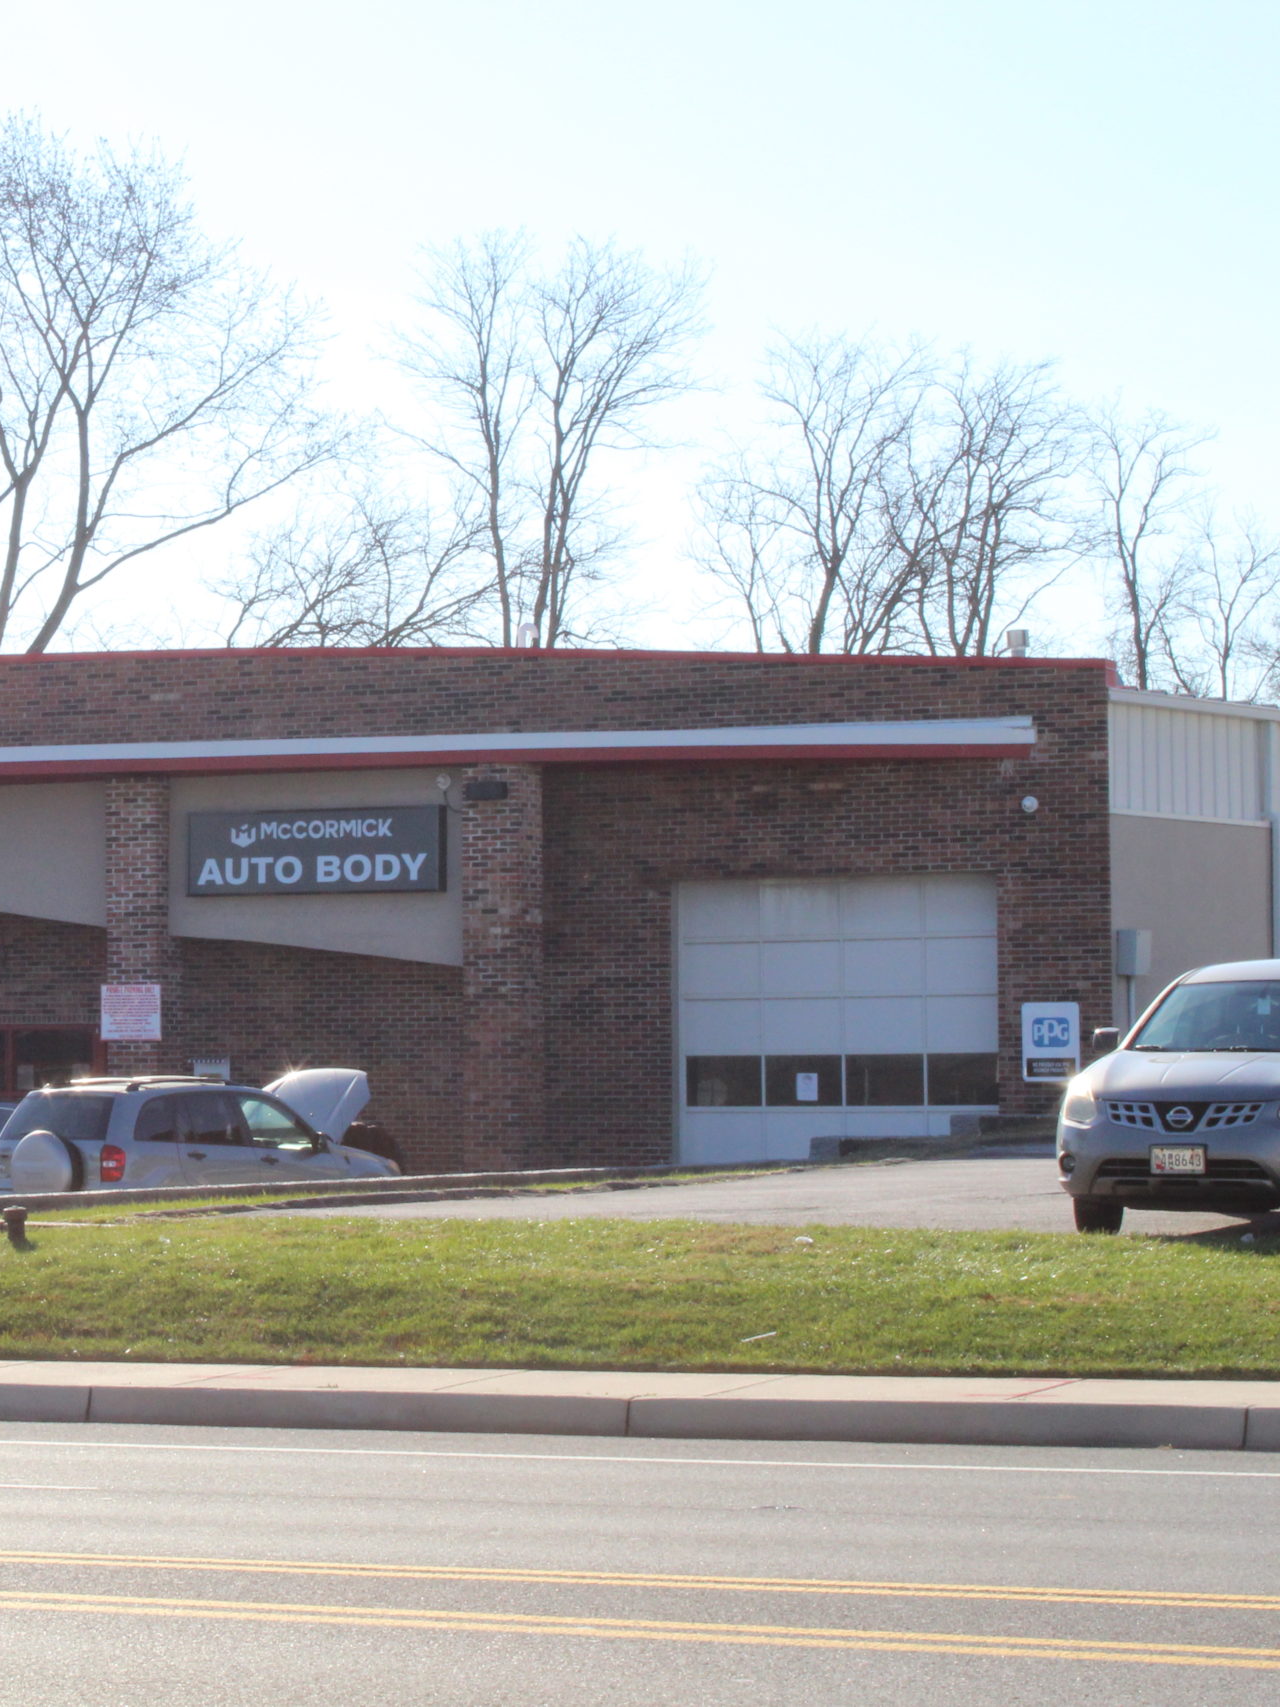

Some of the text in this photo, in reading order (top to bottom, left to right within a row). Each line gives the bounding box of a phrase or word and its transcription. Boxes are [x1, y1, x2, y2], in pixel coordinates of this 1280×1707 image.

[196, 852, 429, 886] AUTO BODY
[1032, 1019, 1069, 1046] PPG
